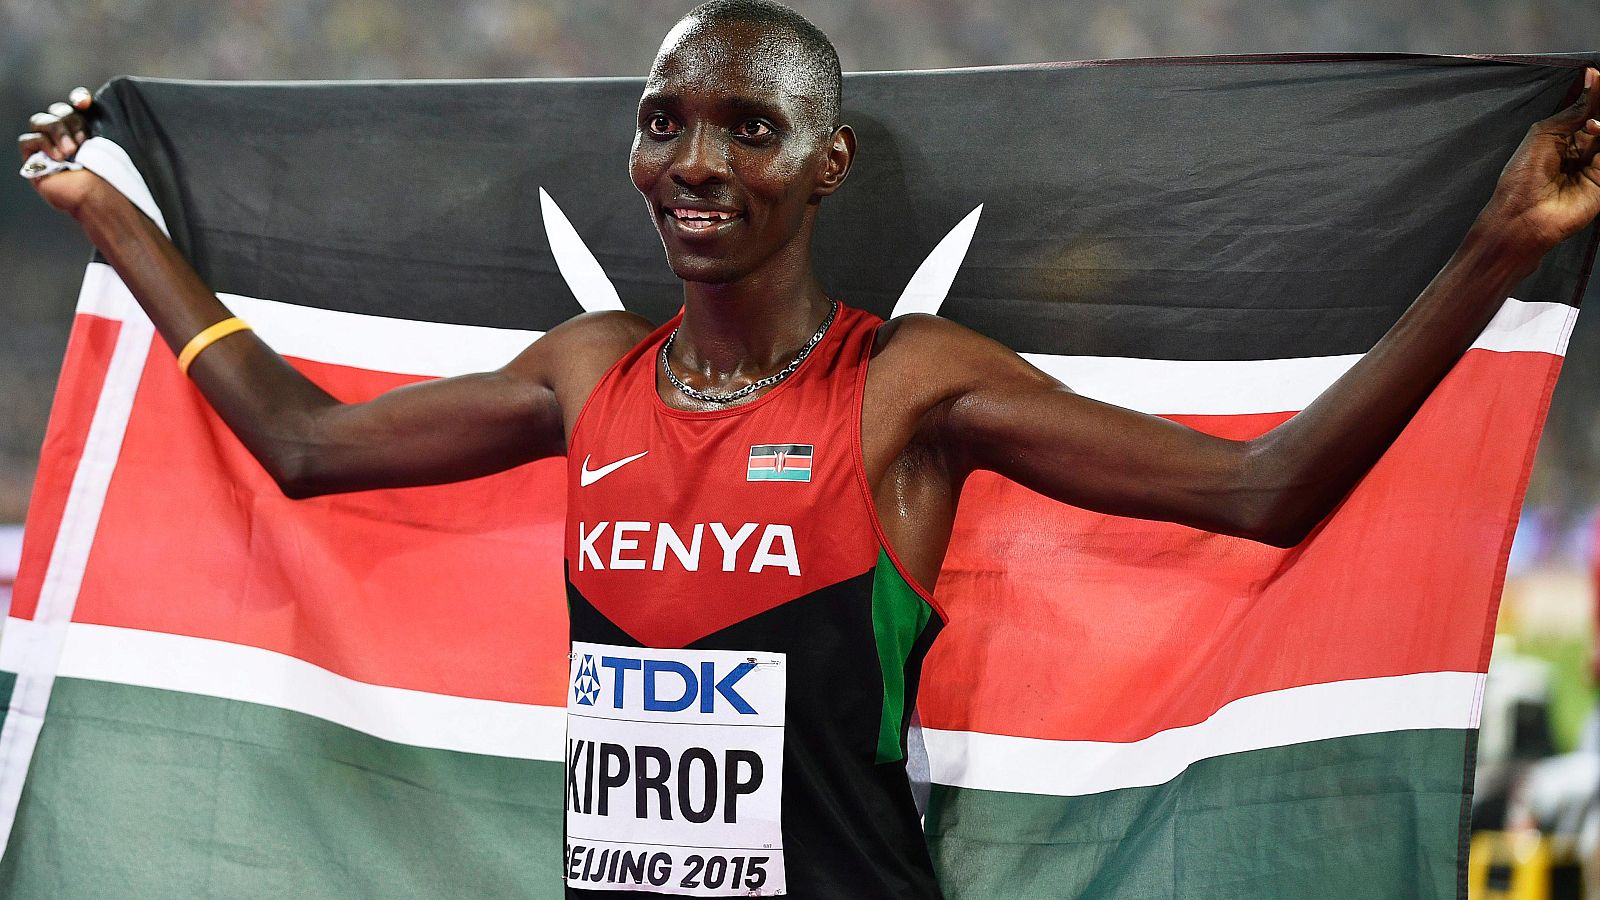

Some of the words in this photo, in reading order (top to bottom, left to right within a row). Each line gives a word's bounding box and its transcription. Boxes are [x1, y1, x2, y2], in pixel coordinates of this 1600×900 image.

[578, 521, 802, 577] KENYA
[601, 656, 760, 715] TDK
[567, 738, 764, 824] KIPROP
[680, 854, 770, 890] 2015
